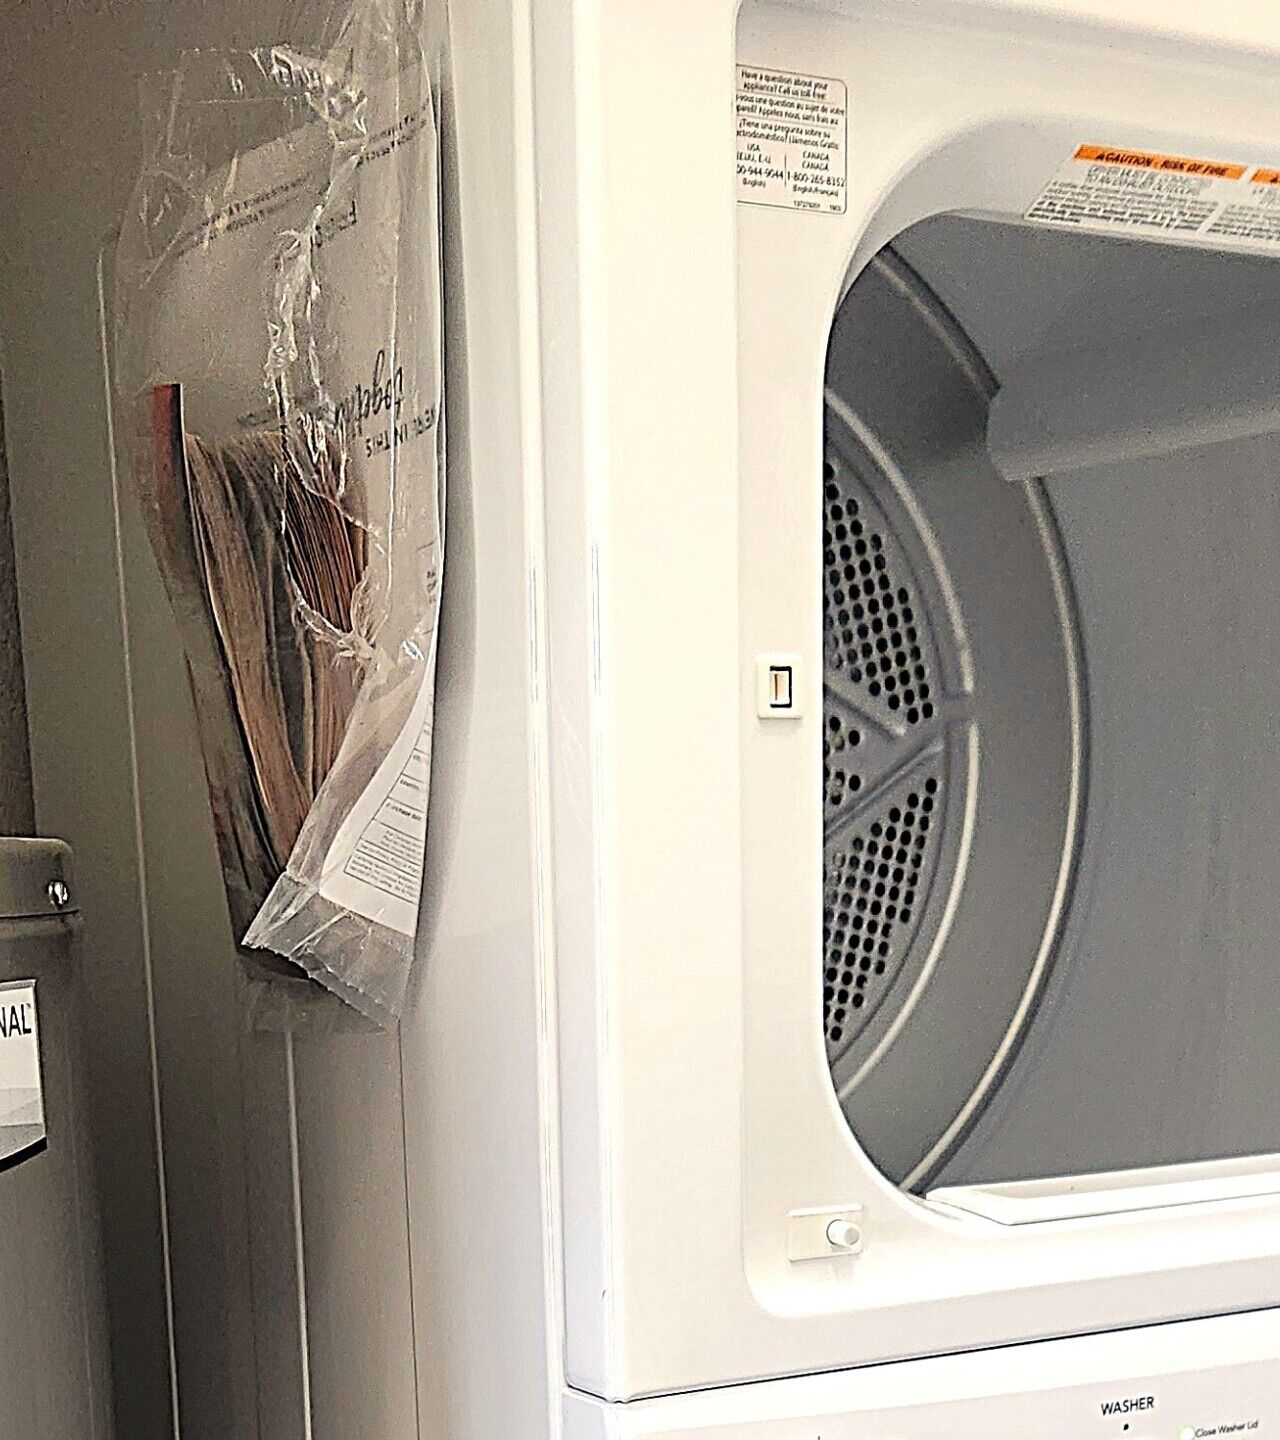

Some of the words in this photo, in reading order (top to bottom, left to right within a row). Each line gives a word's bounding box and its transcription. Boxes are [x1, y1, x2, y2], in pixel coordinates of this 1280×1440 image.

[1100, 1396, 1155, 1416] WASHER
[1195, 1426, 1217, 1438] Close
[1218, 1422, 1245, 1435] Washer
[1247, 1420, 1259, 1430] Lid
